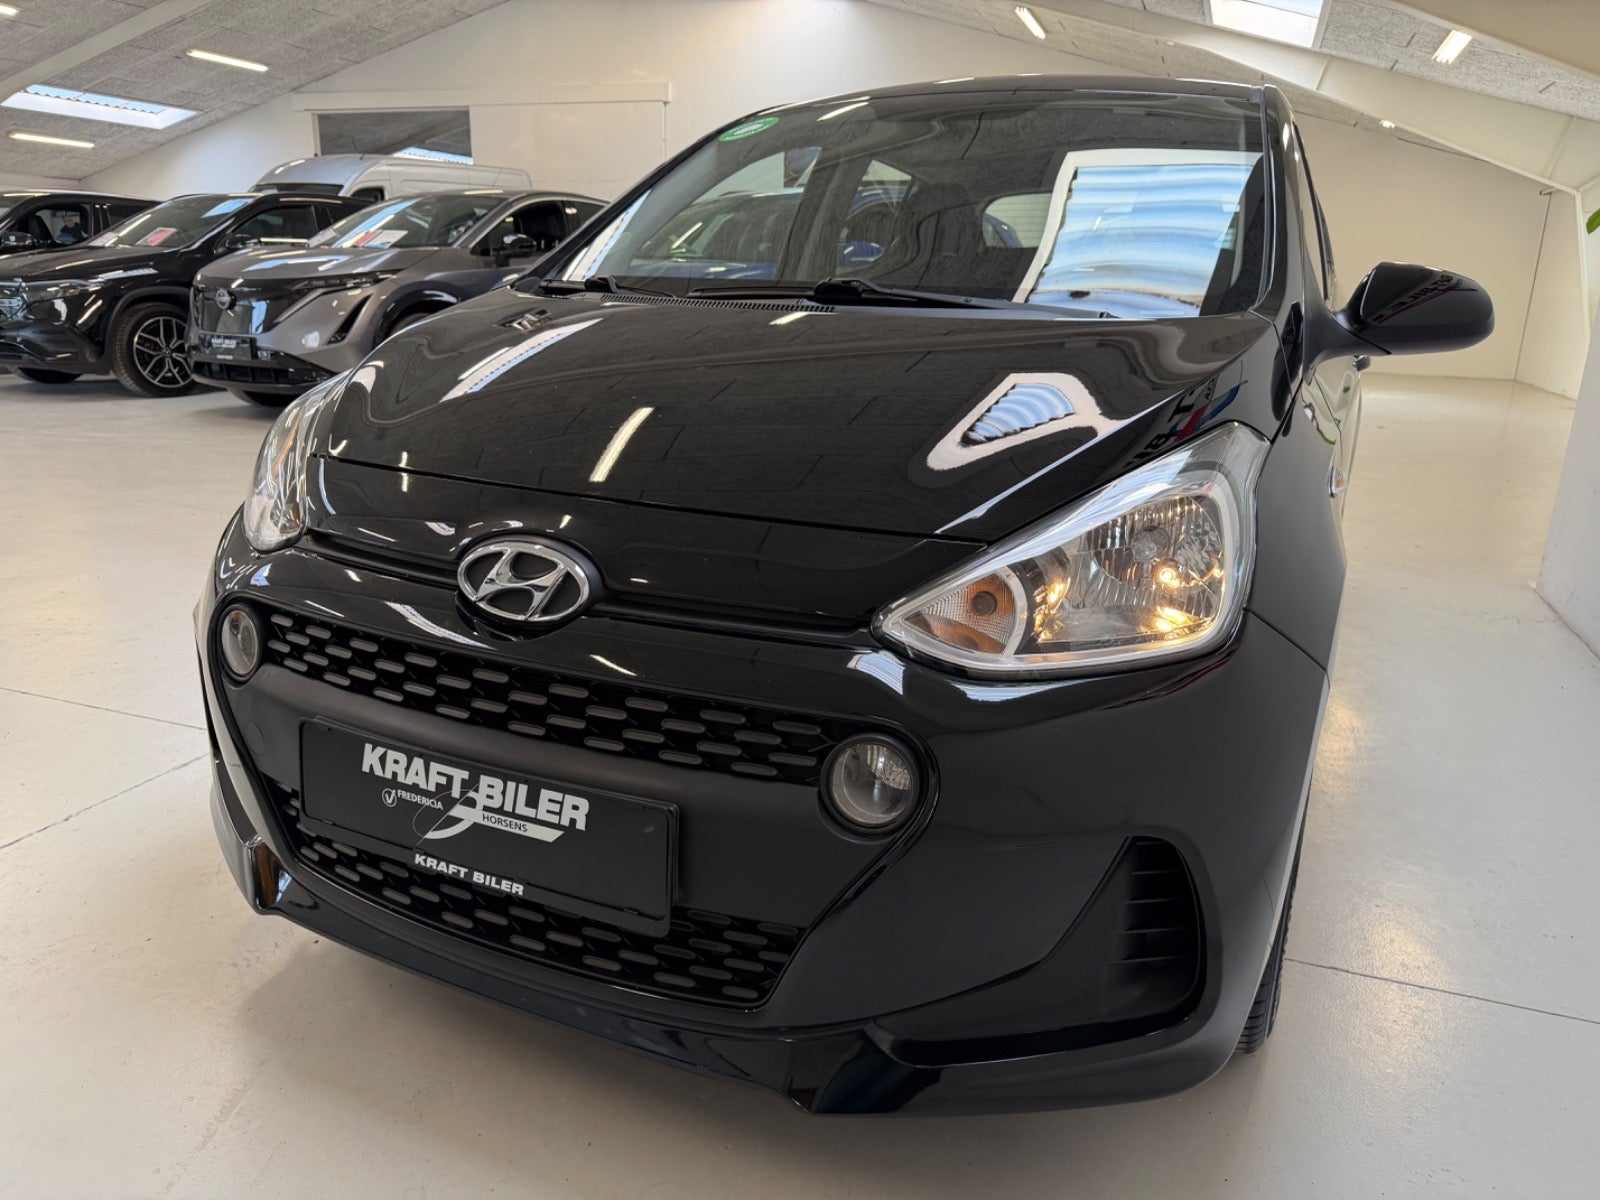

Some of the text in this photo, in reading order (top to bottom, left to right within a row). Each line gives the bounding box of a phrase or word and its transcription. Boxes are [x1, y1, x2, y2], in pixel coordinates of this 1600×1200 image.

[362, 743, 589, 831] KRAFT BILER
[397, 789, 443, 810] FREDERICIA
[483, 813, 528, 832] HORSENS
[414, 854, 524, 896] KRAFT BILER
